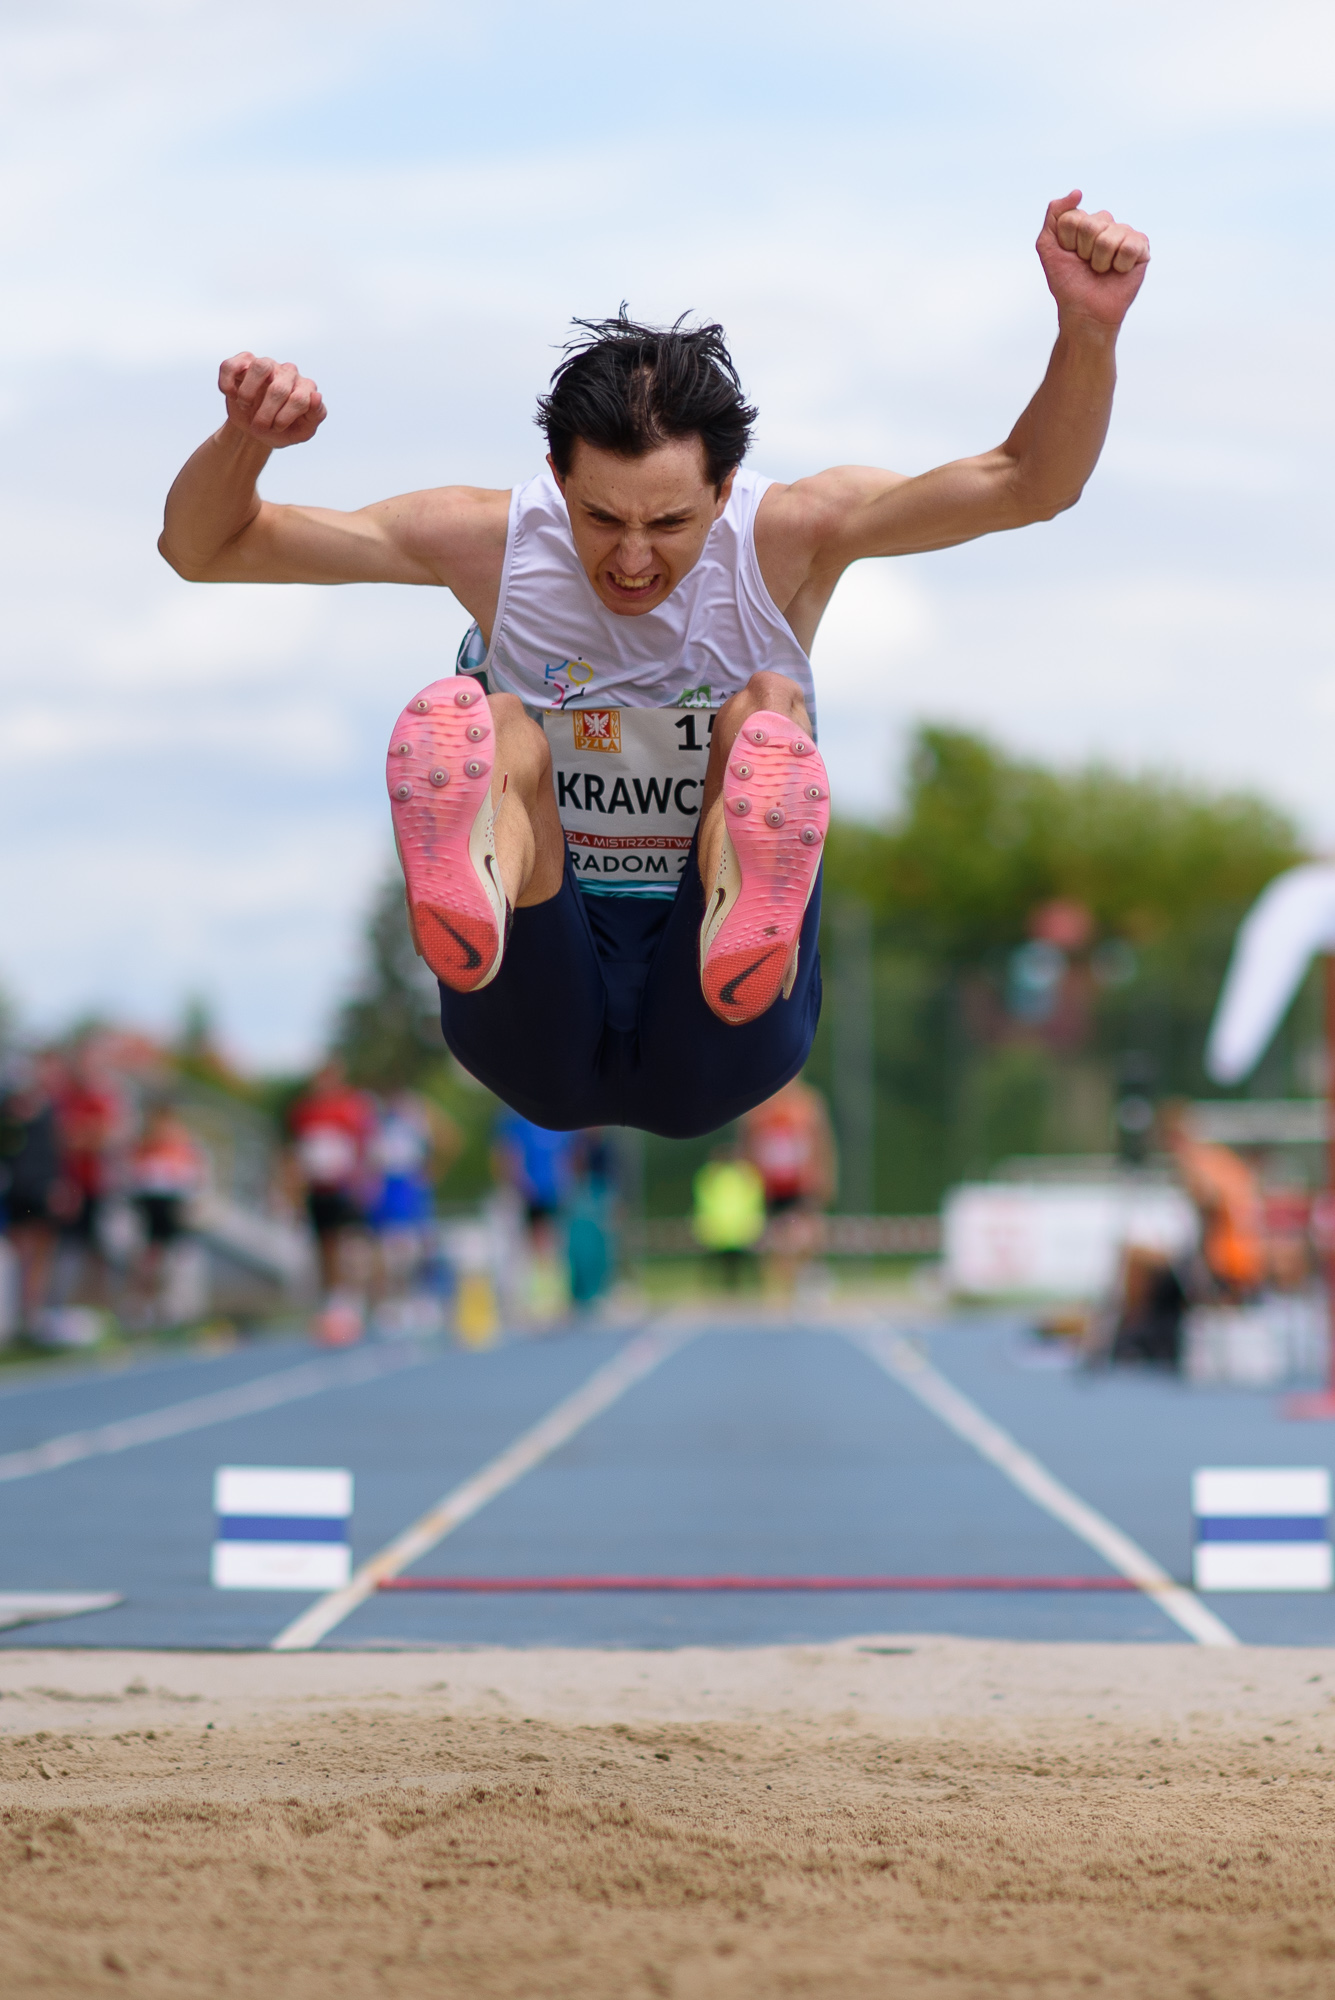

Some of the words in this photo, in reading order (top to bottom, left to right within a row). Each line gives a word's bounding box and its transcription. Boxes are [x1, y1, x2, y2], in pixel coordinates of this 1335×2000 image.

[577, 737, 619, 751] PZLA
[557, 771, 705, 816] KRAWC
[565, 832, 590, 845] ZLA
[569, 851, 669, 874] RADOM
[677, 856, 689, 873] 2
